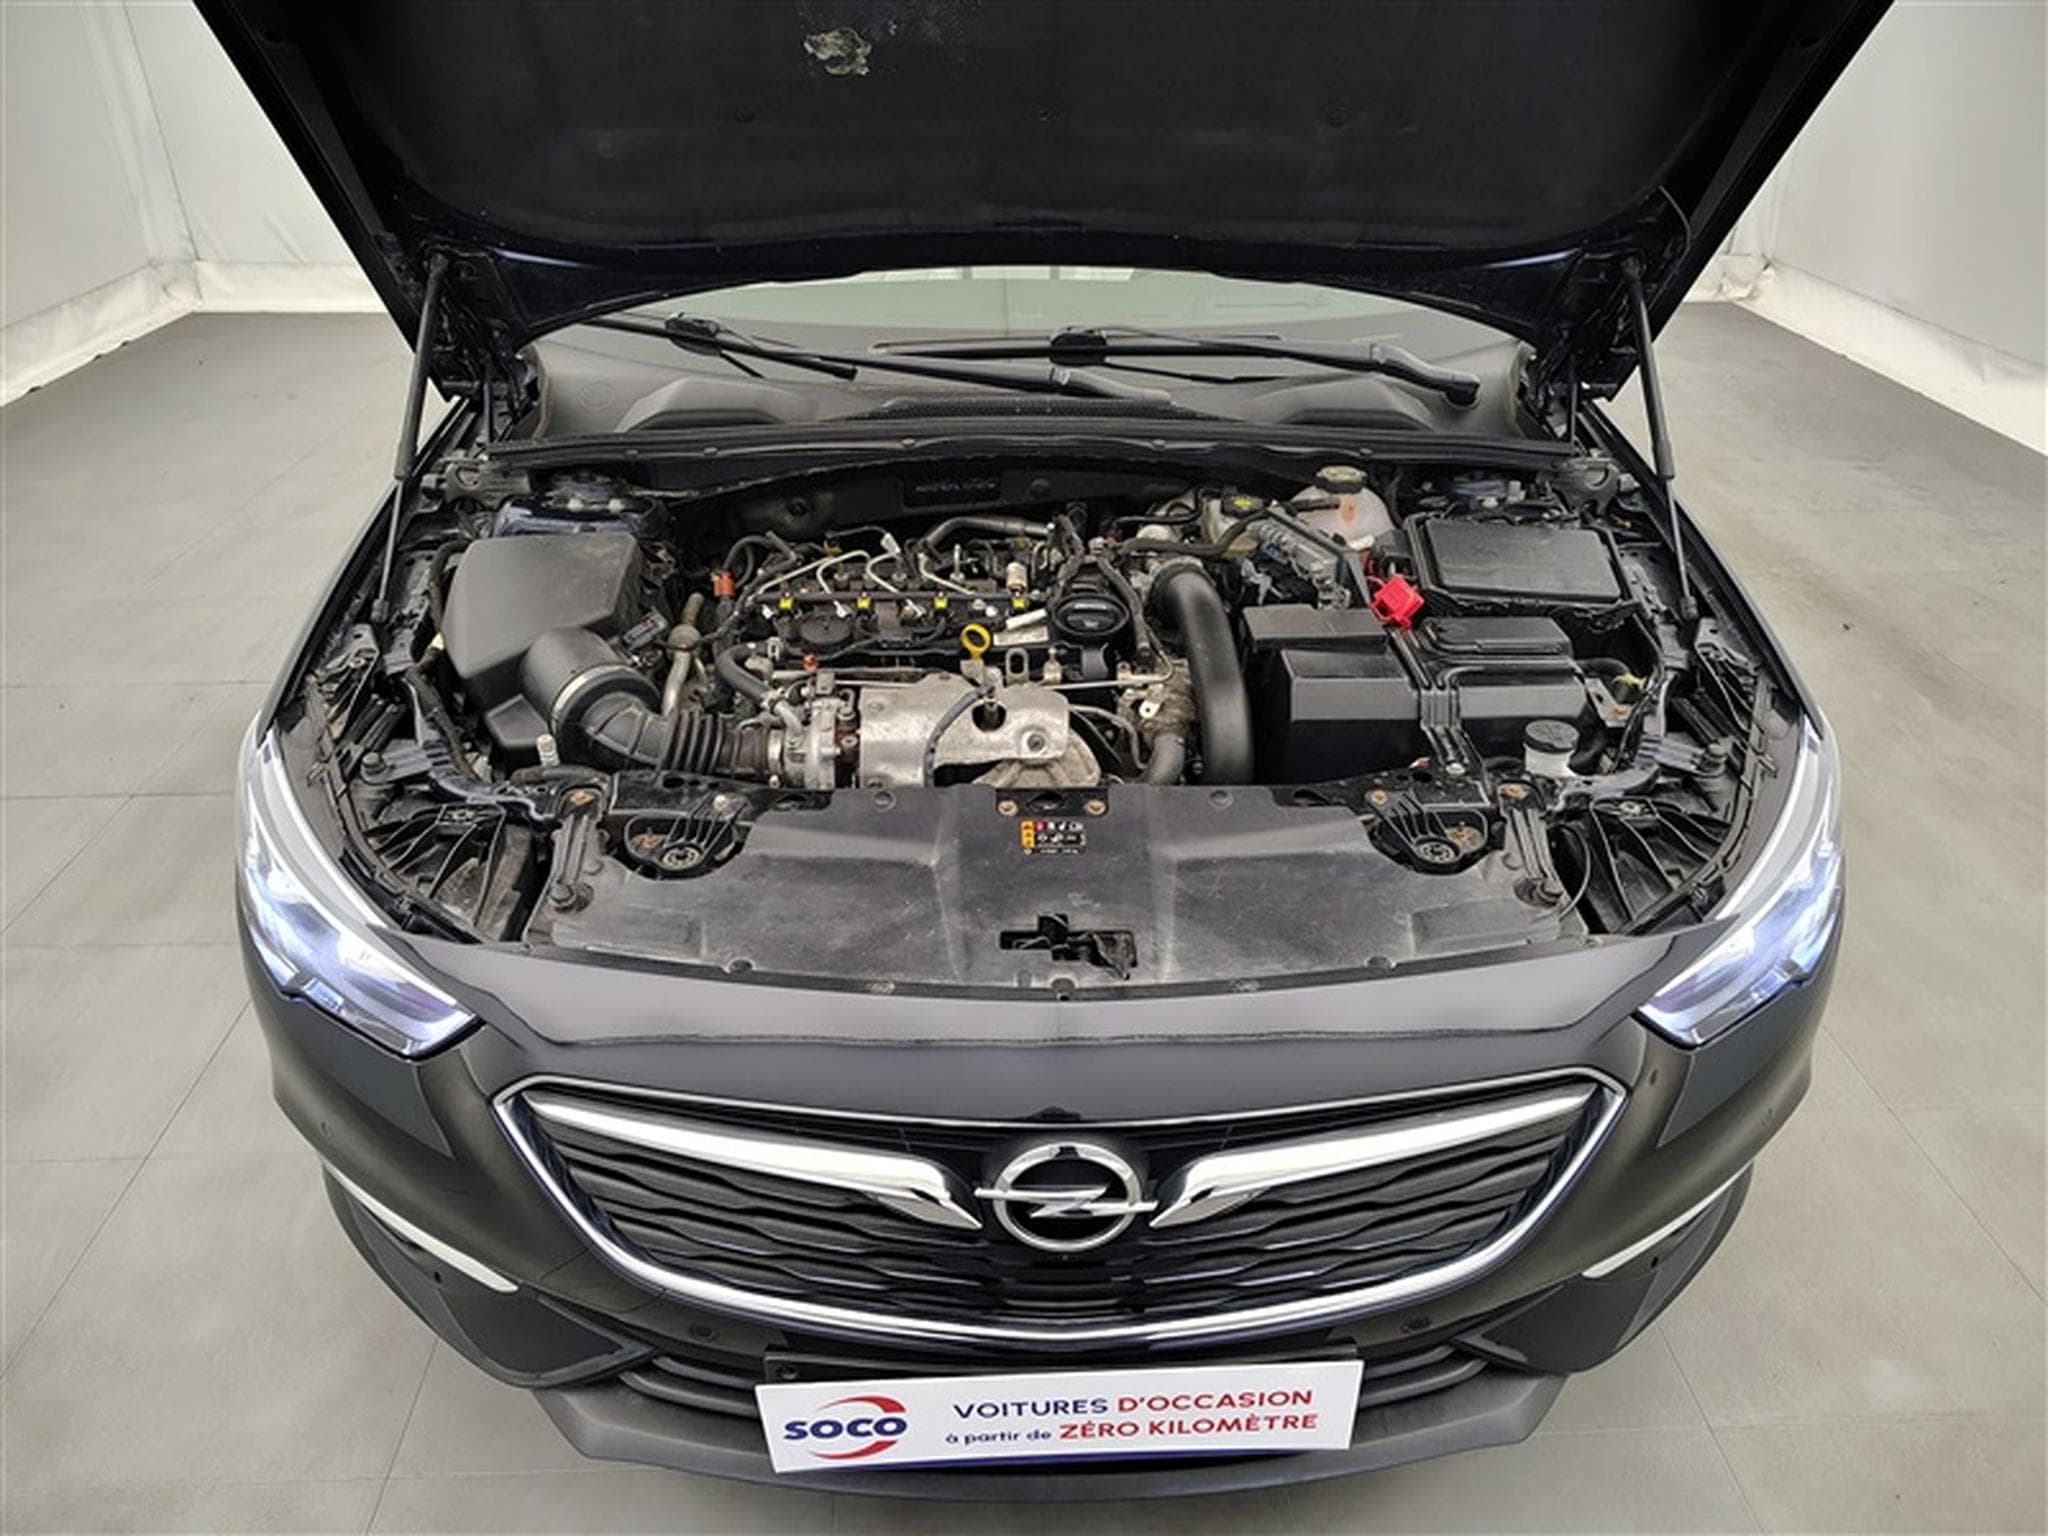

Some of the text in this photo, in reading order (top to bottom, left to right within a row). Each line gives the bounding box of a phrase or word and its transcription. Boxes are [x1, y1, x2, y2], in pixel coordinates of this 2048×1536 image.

[953, 1389, 1313, 1419] VOITURES D'OCCASION
[784, 1417, 907, 1440] SOCO
[964, 1430, 1020, 1446] partir
[1026, 1429, 1052, 1440] de
[1059, 1420, 1140, 1440] ZÉRO
[1148, 1413, 1319, 1436] KILOMÈTRE
